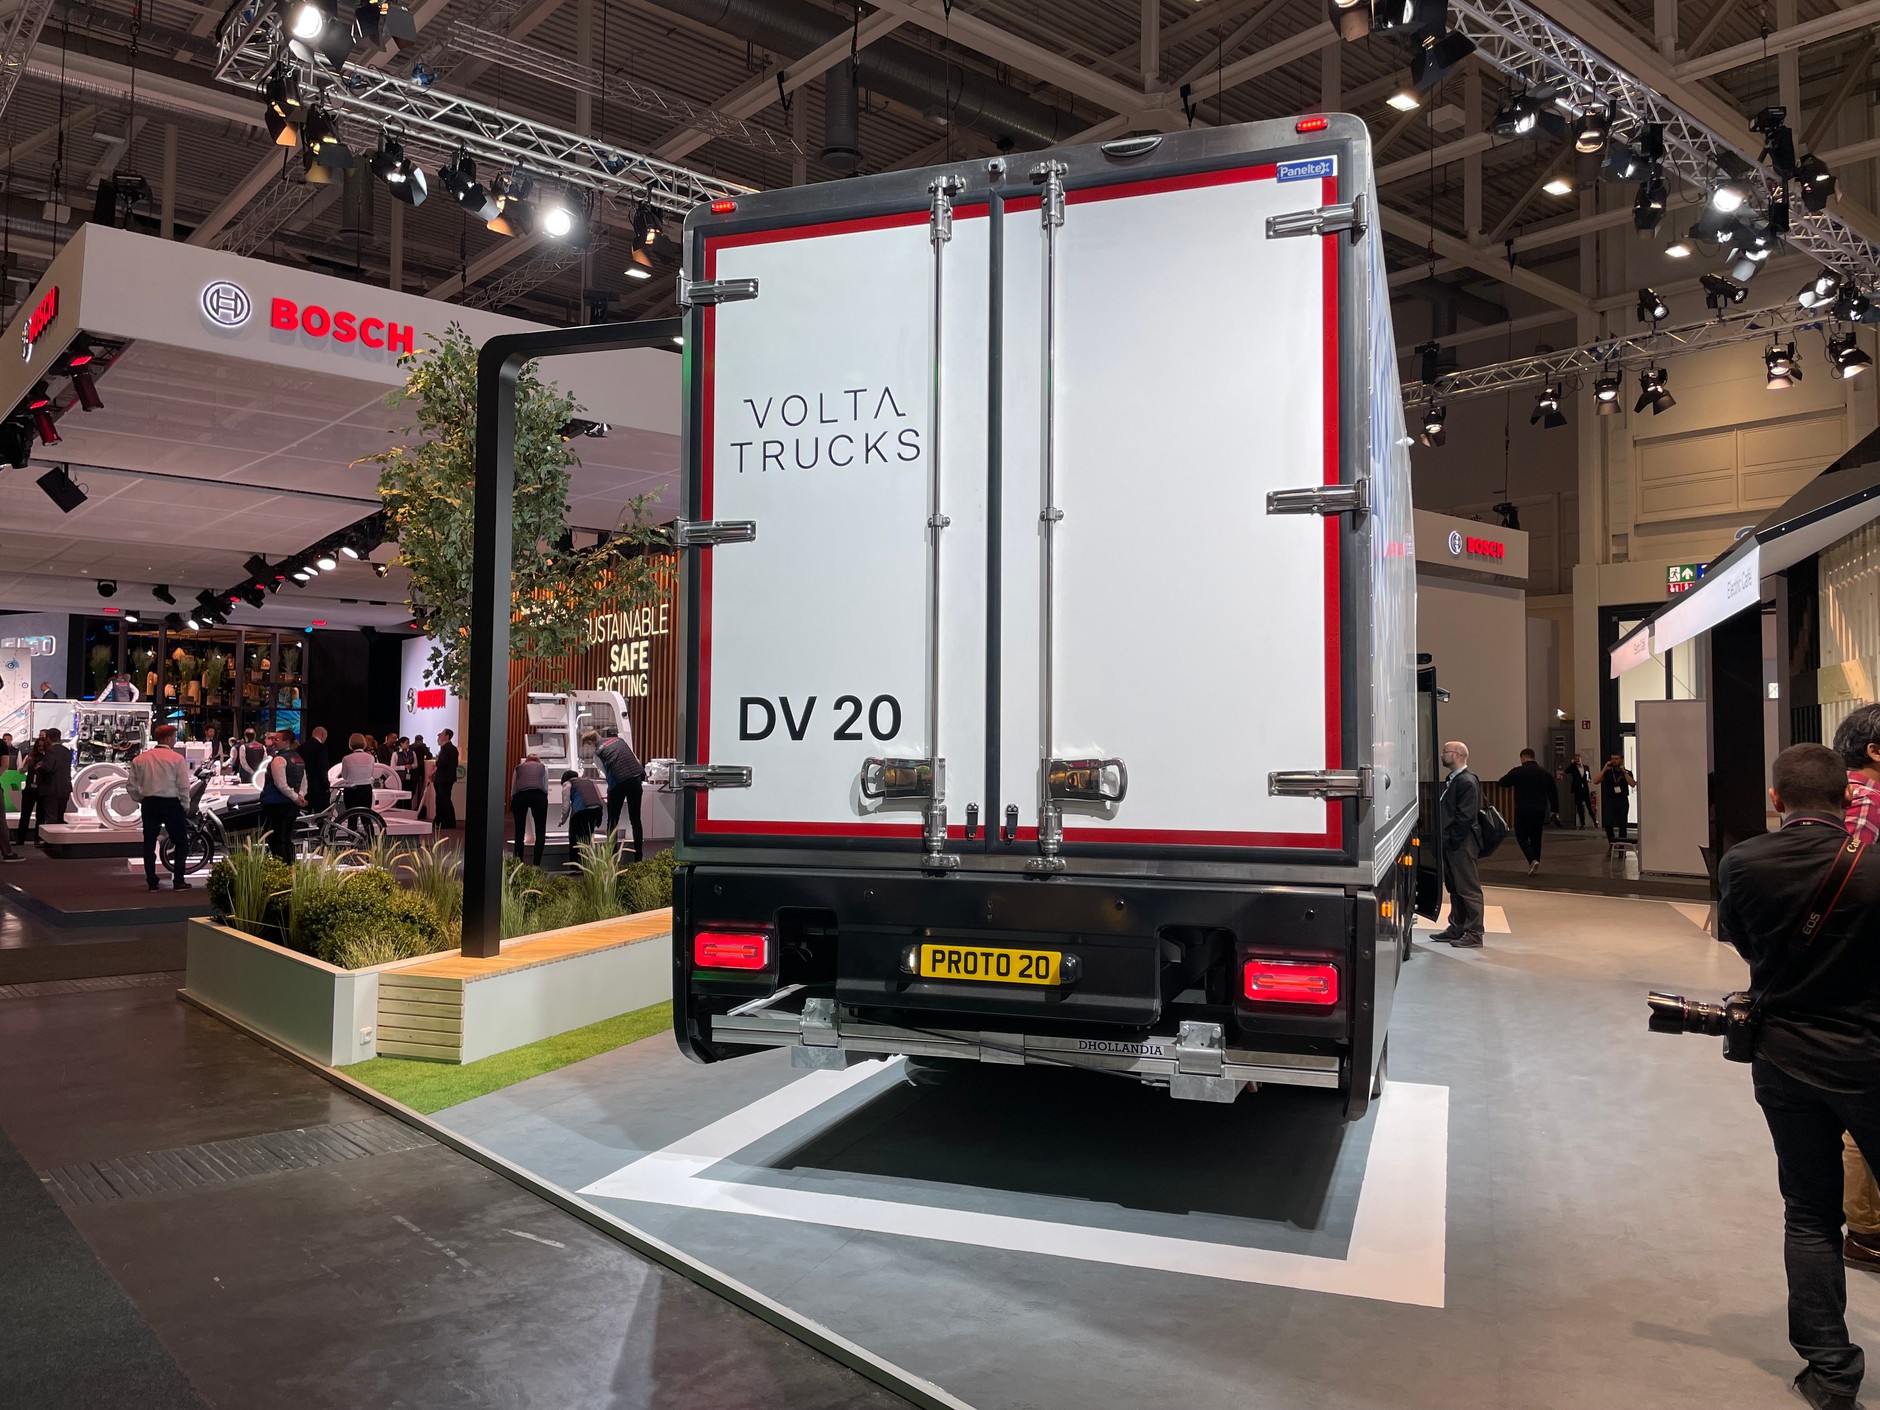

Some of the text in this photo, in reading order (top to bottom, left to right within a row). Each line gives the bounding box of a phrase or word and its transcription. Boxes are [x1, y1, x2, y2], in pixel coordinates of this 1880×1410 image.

[1280, 162, 1330, 177] Paneltex
[270, 297, 414, 355] BOSCH
[743, 386, 907, 429] VOLTA
[730, 428, 921, 474] TRUCKS
[1466, 536, 1505, 559] BOSCH
[610, 640, 650, 673] SAFE
[596, 673, 648, 698] EXCITING
[739, 694, 902, 741] DV 20
[1802, 912, 1821, 935] EOS
[931, 949, 1050, 980] PROTO 20
[1078, 1040, 1163, 1056] DHOLLANDIA
